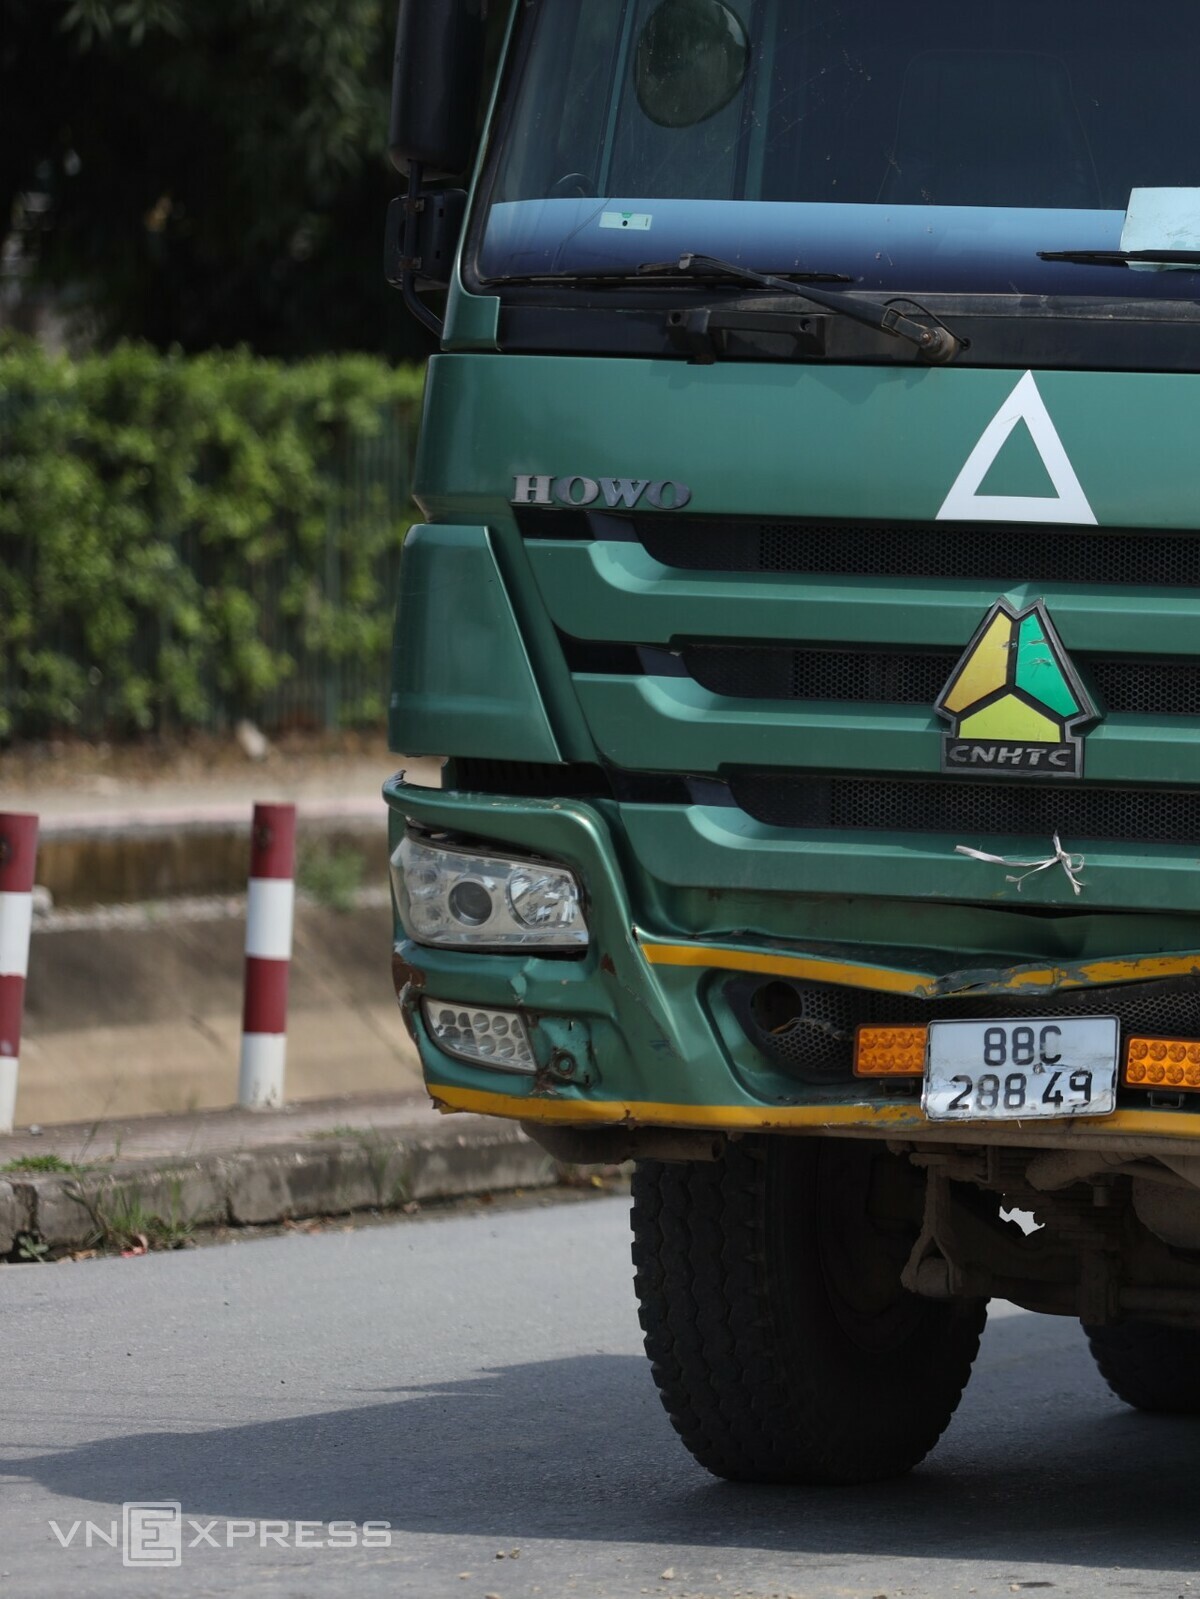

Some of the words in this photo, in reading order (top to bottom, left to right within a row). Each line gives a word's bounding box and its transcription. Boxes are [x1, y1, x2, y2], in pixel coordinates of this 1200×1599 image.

[512, 474, 691, 510] HOWO
[949, 745, 1071, 766] CNHTC
[983, 1025, 1062, 1066] 88C
